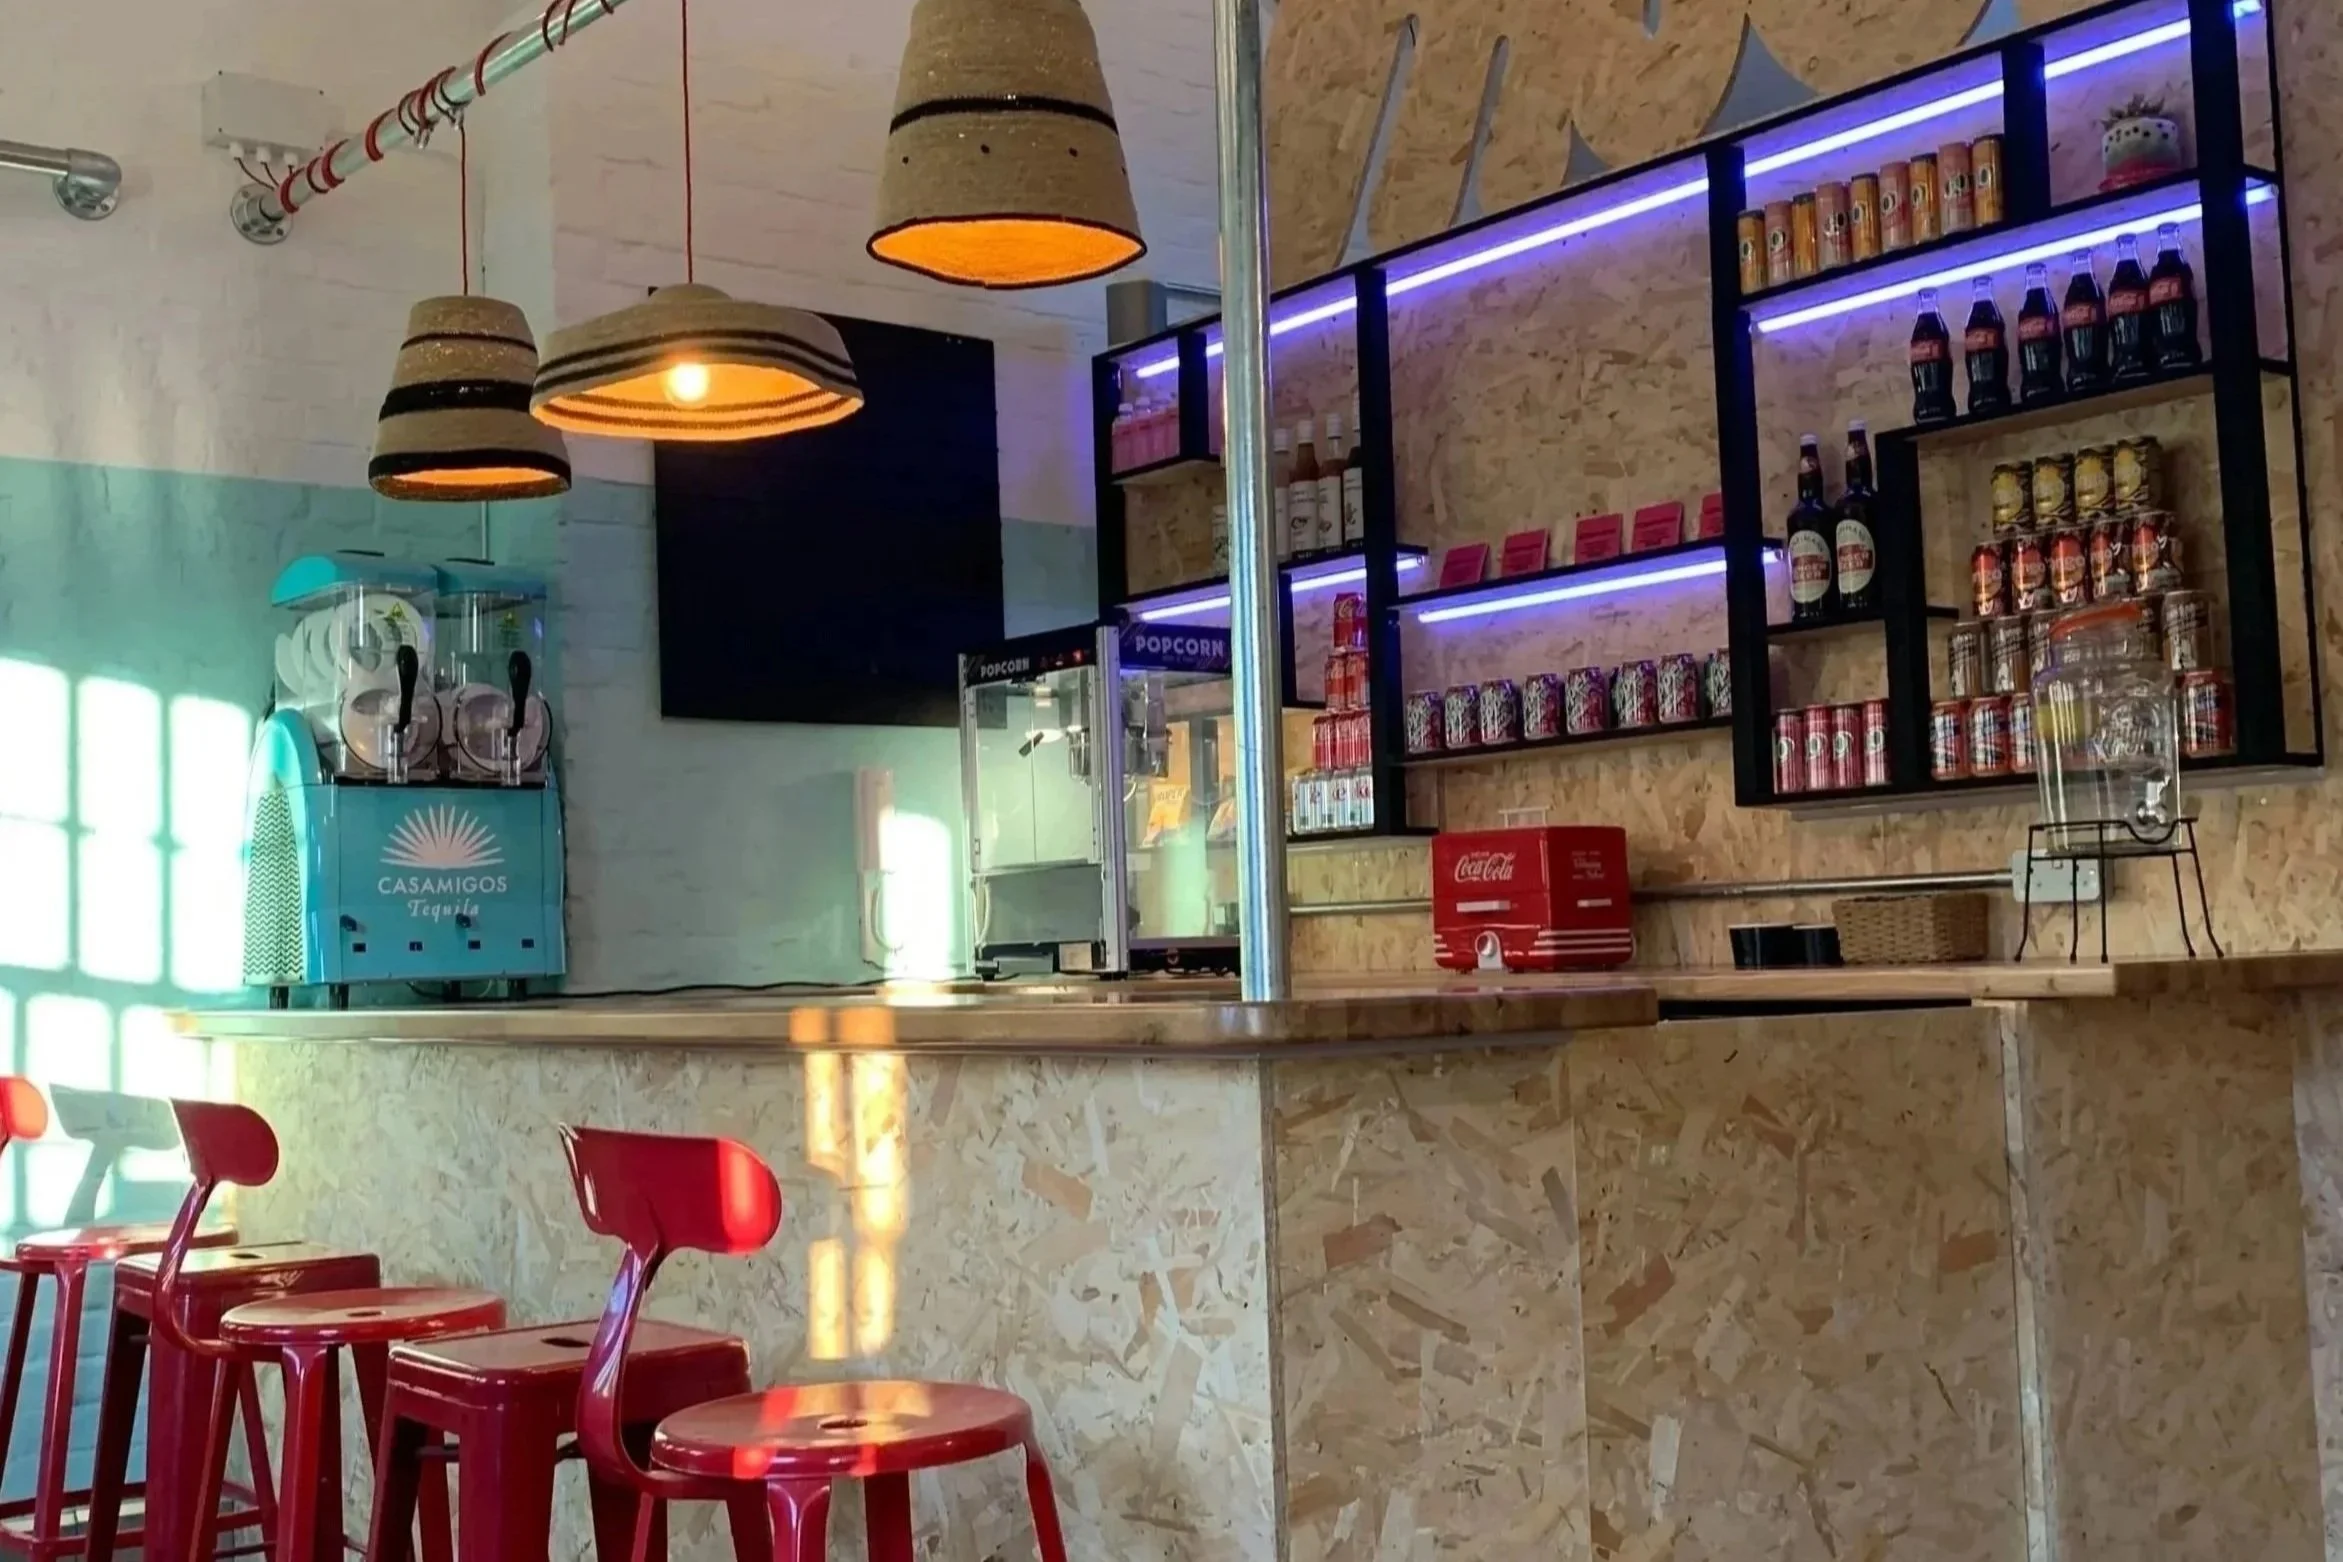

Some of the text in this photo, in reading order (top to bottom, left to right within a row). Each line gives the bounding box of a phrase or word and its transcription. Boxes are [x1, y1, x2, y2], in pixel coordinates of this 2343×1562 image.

[1135, 635, 1224, 657] POPCORN
[980, 657, 1029, 678] POPCORN
[1454, 853, 1515, 882] Coca-Cola
[378, 876, 507, 894] CASAMIGOS
[408, 898, 479, 923] Tequila
